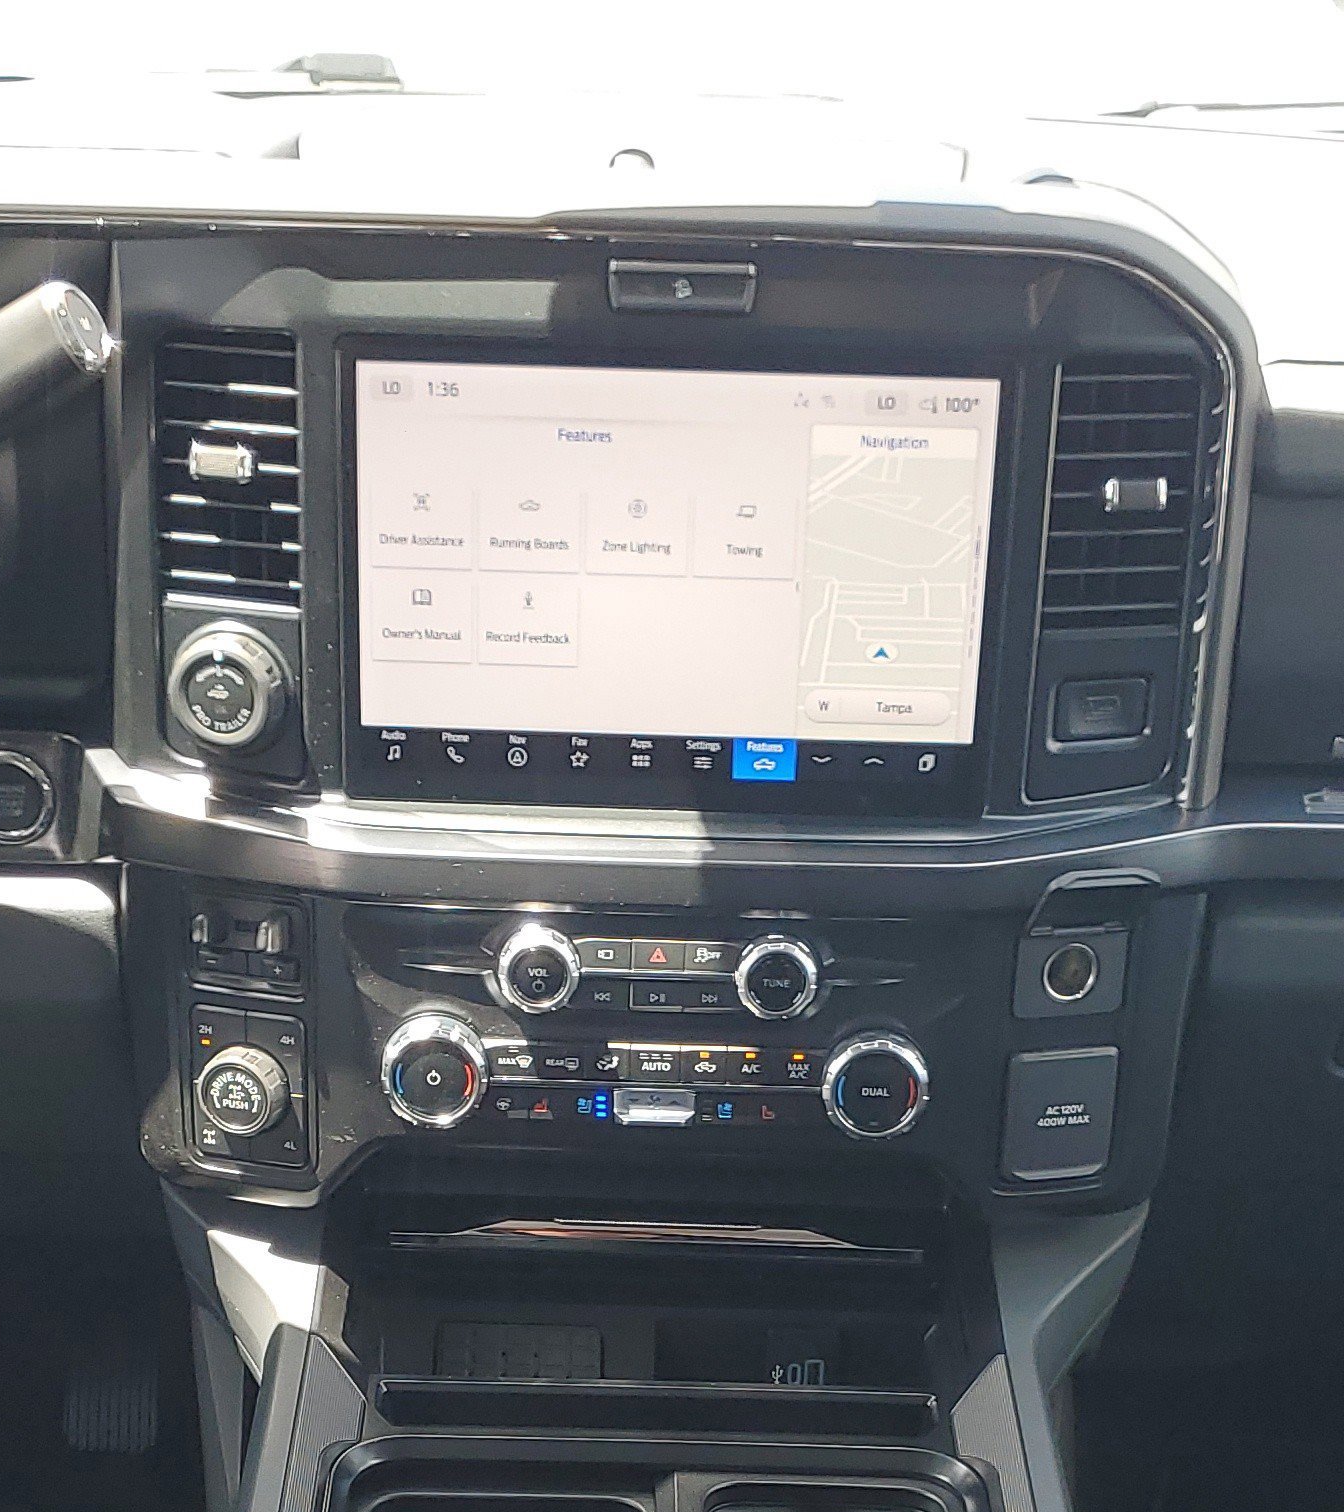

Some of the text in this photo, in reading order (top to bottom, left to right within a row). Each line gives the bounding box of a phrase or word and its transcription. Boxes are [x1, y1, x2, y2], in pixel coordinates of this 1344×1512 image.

[382, 381, 401, 395] LO
[427, 381, 459, 397] 1:36
[877, 396, 896, 410] LO
[557, 428, 613, 443] Features
[860, 435, 930, 450] Navigation
[379, 534, 464, 547] Driver Assistance
[490, 537, 570, 551] Running Boards
[602, 540, 671, 555] Zone Lighting
[726, 544, 763, 558] Towing
[382, 628, 461, 641] Owner's Manual
[485, 631, 570, 645] Record Feedback
[818, 701, 830, 711] W
[876, 701, 913, 714] Tampa
[192, 705, 251, 731] PRO TRAILER
[381, 730, 406, 741] Audio
[442, 732, 470, 743] Phone
[509, 735, 527, 745] Nav
[571, 737, 589, 747] Fav
[630, 739, 653, 750] Apps
[686, 740, 722, 752] Settings
[747, 741, 784, 752] Features
[528, 967, 549, 979] VOL
[762, 978, 791, 988] TUNE
[198, 1025, 213, 1035] 2H
[279, 1036, 295, 1046] 4H
[545, 1059, 564, 1067] REAR
[641, 1062, 672, 1072] AUTO
[741, 1063, 761, 1074] A/C
[787, 1063, 810, 1071] MAX
[789, 1071, 808, 1080] A/C
[210, 1071, 261, 1101] DRIVE MODE
[861, 1087, 891, 1098] DUAL
[222, 1098, 249, 1110] PUSH
[1045, 1103, 1085, 1115] AC 120V
[1037, 1114, 1090, 1127] 400W MAX
[283, 1141, 297, 1151] 4L
